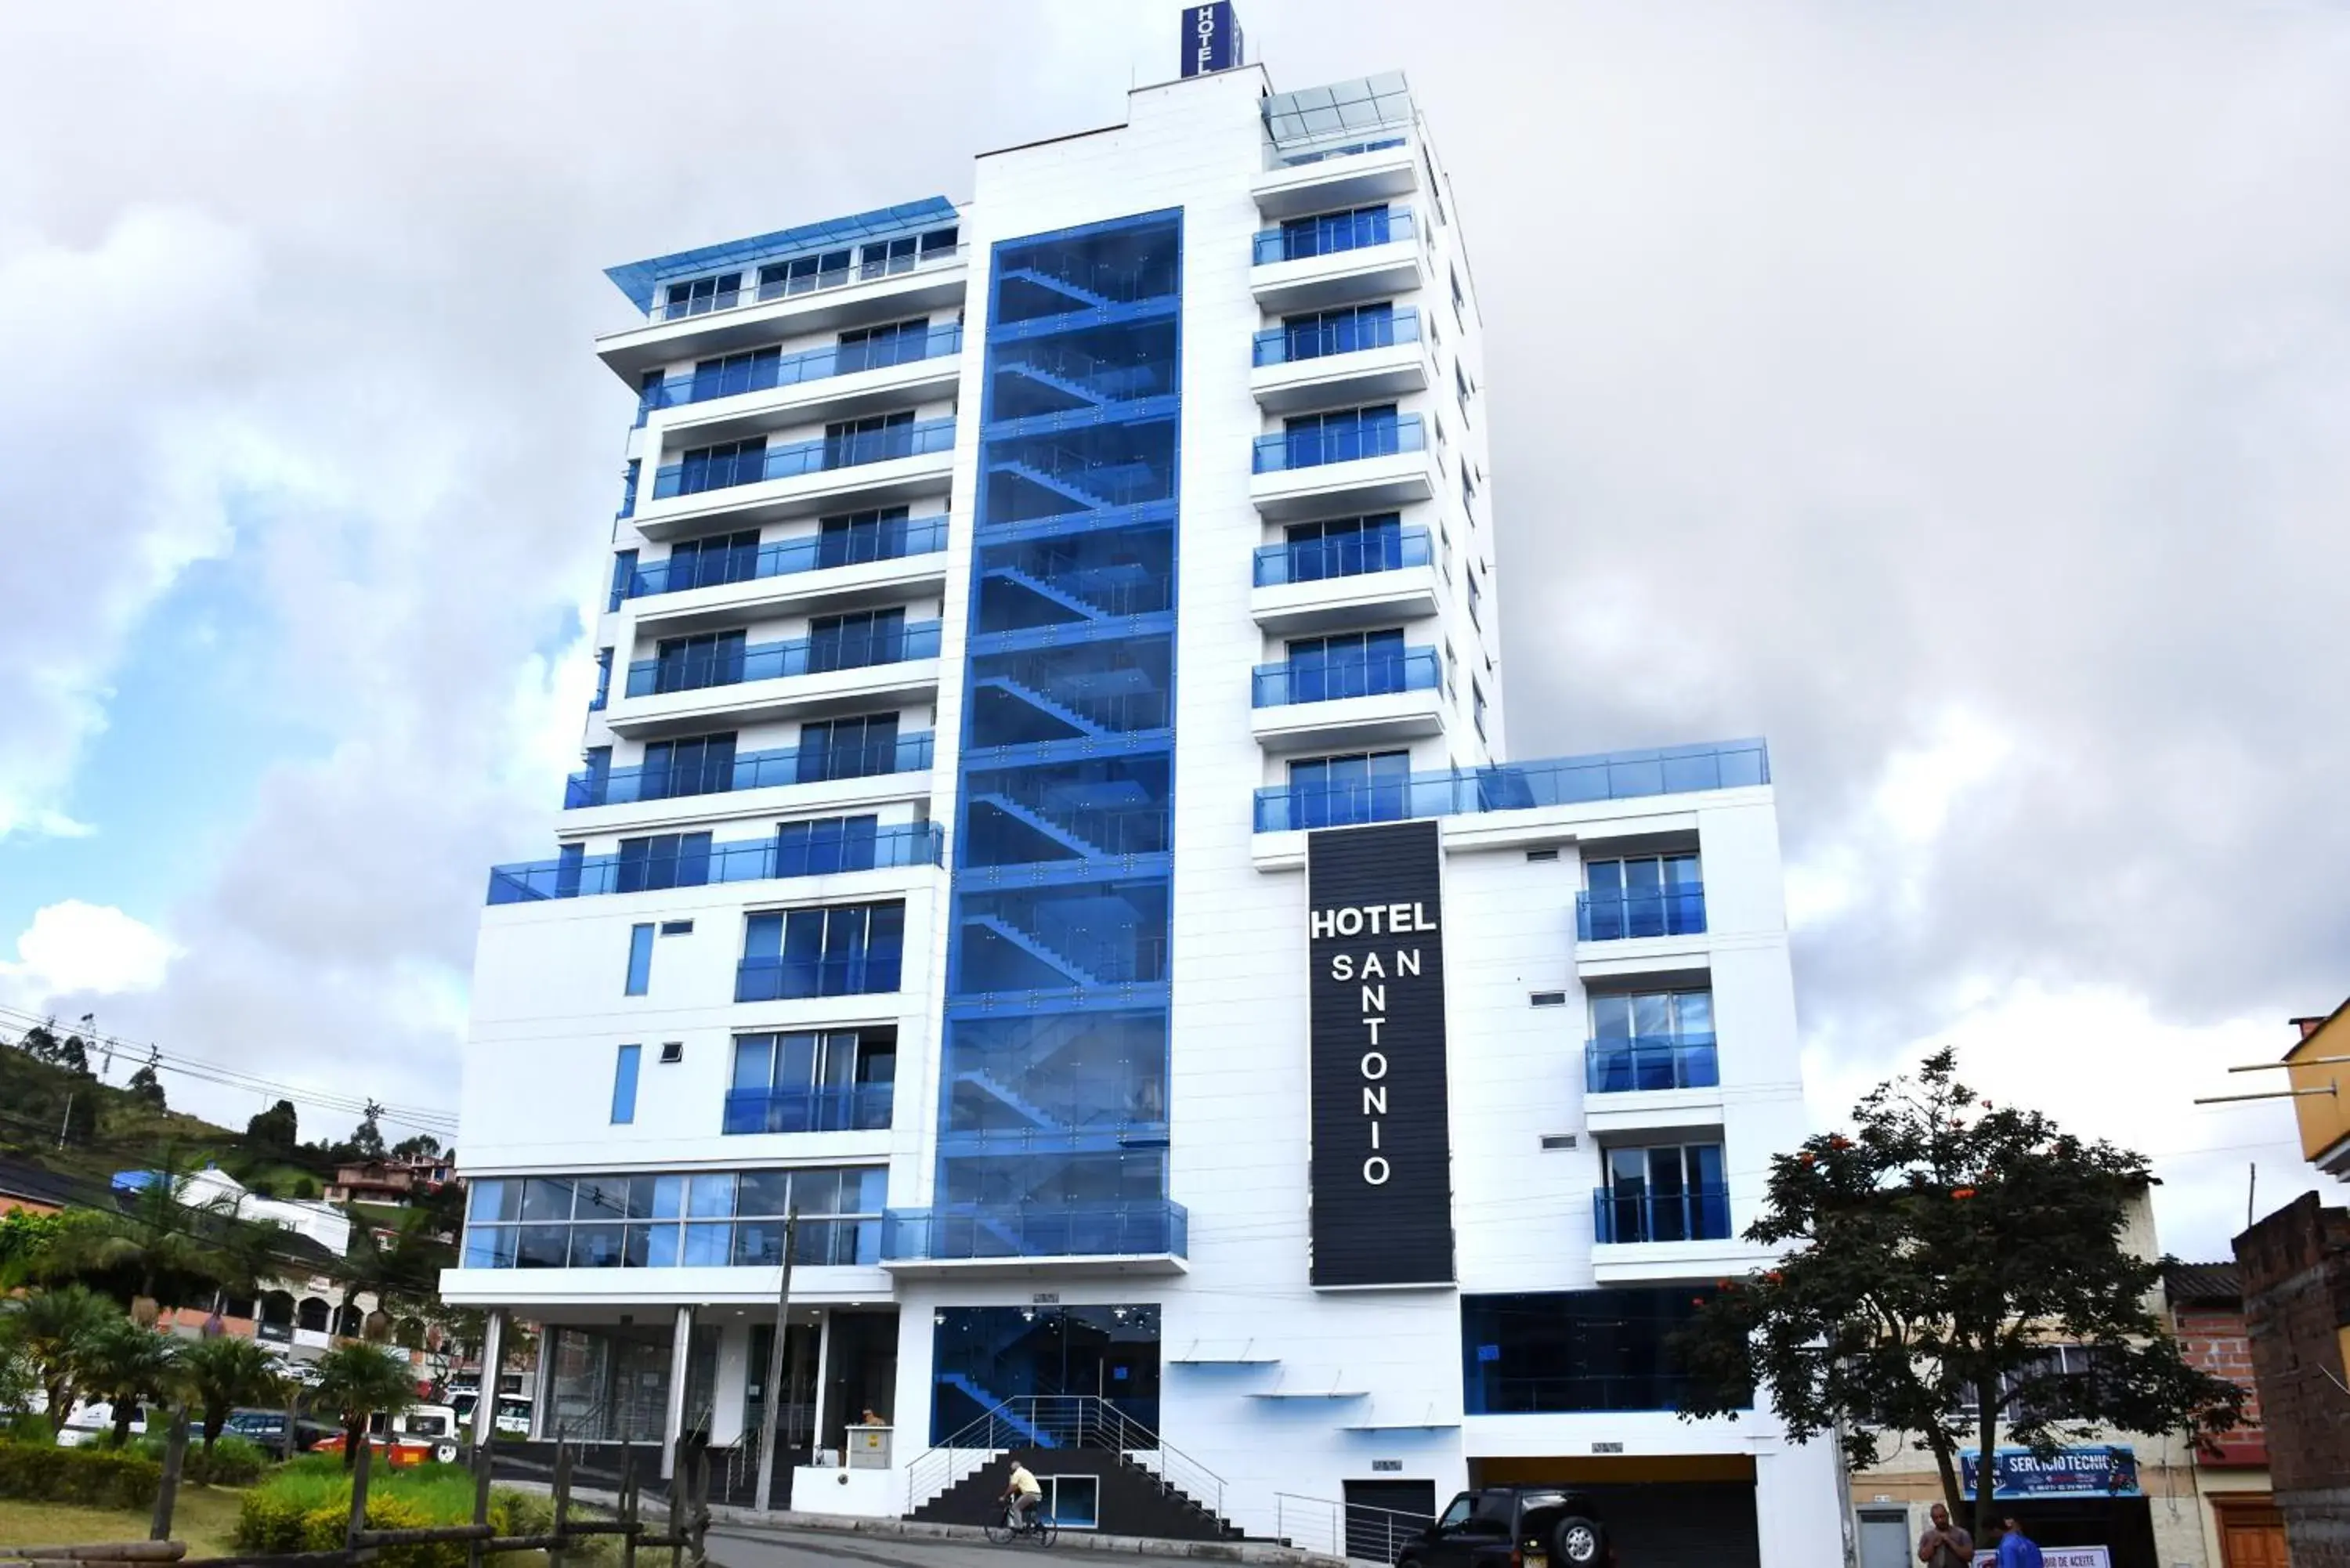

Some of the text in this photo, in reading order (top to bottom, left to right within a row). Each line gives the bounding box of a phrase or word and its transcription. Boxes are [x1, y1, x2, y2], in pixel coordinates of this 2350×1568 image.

[1198, 6, 1214, 74] HOTEL
[1311, 901, 1437, 938] HOTEL
[1332, 948, 1421, 981] SAN
